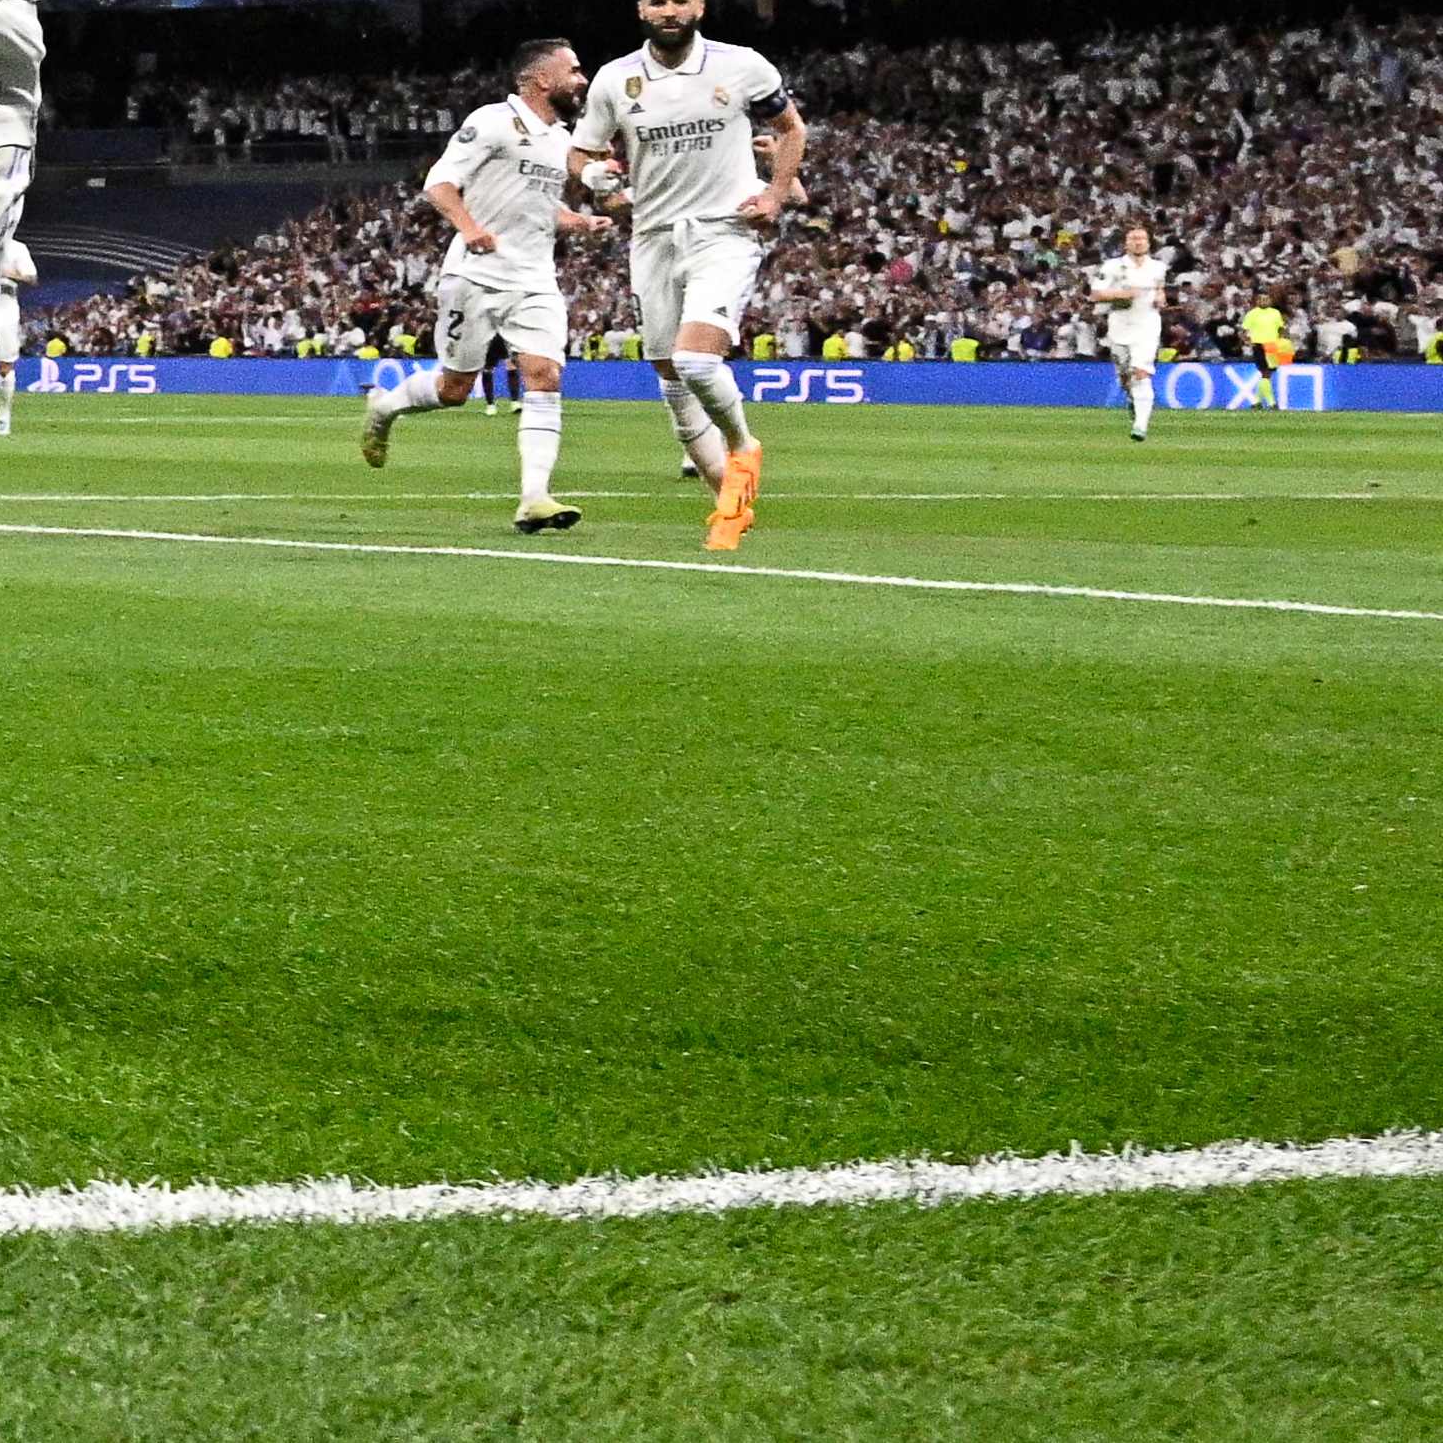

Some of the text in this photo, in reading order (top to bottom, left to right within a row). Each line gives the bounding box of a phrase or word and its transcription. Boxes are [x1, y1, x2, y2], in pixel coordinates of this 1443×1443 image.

[635, 117, 725, 142] Emirates
[447, 309, 465, 341] 2
[73, 363, 157, 394] PS5
[752, 367, 865, 404] PS5
